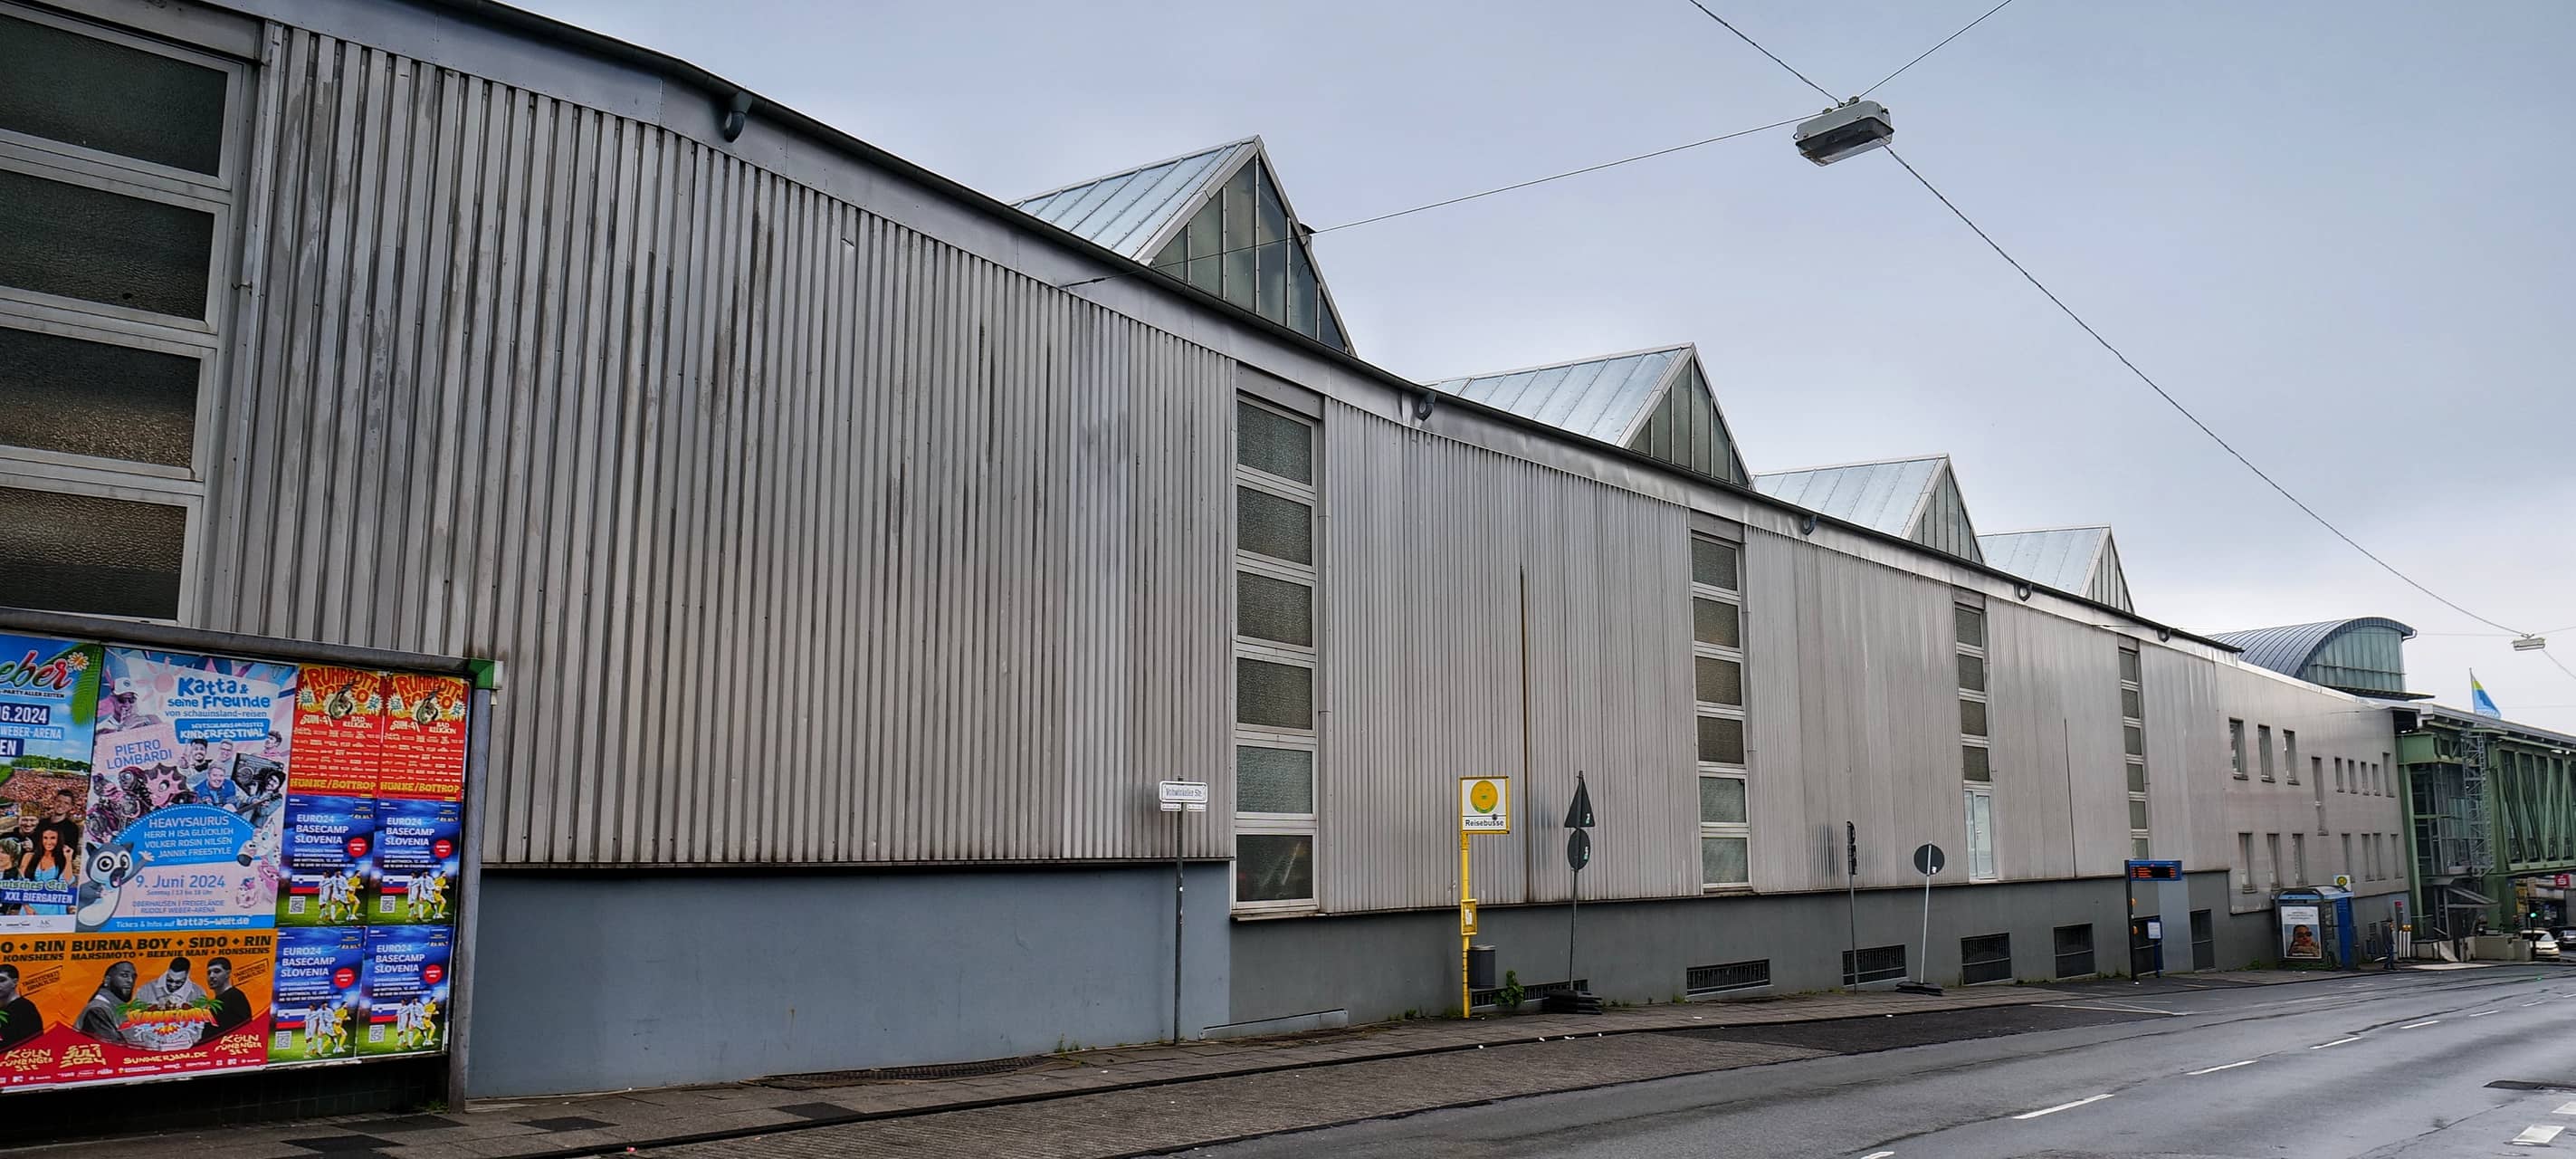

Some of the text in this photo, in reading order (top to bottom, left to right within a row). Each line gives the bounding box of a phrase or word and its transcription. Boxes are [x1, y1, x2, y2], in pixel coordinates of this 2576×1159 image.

[306, 668, 379, 689] RUHRPOTT
[178, 677, 249, 696] Katta &
[395, 675, 463, 696] RUHRPOTT
[167, 695, 271, 709] seine Freunde
[0, 705, 47, 724] 6.2024
[183, 709, 267, 718] schauinsland-reisen
[1, 726, 62, 740] WEBER-ARENA
[180, 728, 265, 740] KINDERFESTIVAL
[115, 739, 161, 757] PIETRO
[106, 749, 173, 770] LOMBARDI
[148, 816, 229, 829] HEAVYSAURUS
[296, 814, 335, 823] EURO24
[386, 817, 423, 826] EURO24
[1465, 819, 1504, 827] Reisebusse
[144, 830, 167, 838] HERR
[191, 827, 234, 836] GLÜCKLICH
[296, 825, 349, 835] BASECAMP
[386, 827, 435, 837] BASECAMP
[144, 837, 233, 848] VOLKER ROSIN NILSEN
[294, 835, 343, 845] SLOVENIA
[385, 837, 430, 846] SLOVENIA
[188, 848, 232, 856] FREESTYLE
[136, 876, 226, 888] 9. Juni 2024
[5, 891, 72, 904] XXL BIERGARTEN
[132, 900, 177, 908] OBERHAUSEN
[33, 940, 65, 952] RIN
[72, 935, 272, 952] BURNA BOY SIDO RIN
[377, 944, 413, 953] EURO24
[71, 947, 271, 961] MARSIMOTO BEENIE MAN KONSHENS
[282, 947, 322, 956] EURO24
[3, 953, 64, 963] KONSHENS
[282, 957, 336, 967] BASECAMP
[376, 953, 425, 963] BASECAMP
[281, 968, 329, 977] SLOVENIA
[374, 964, 419, 973] SLOVENIA
[221, 1034, 259, 1043] KÖLN
[5, 1049, 52, 1060] KÖLN
[123, 1051, 208, 1065] SUMMERJAM.DE
